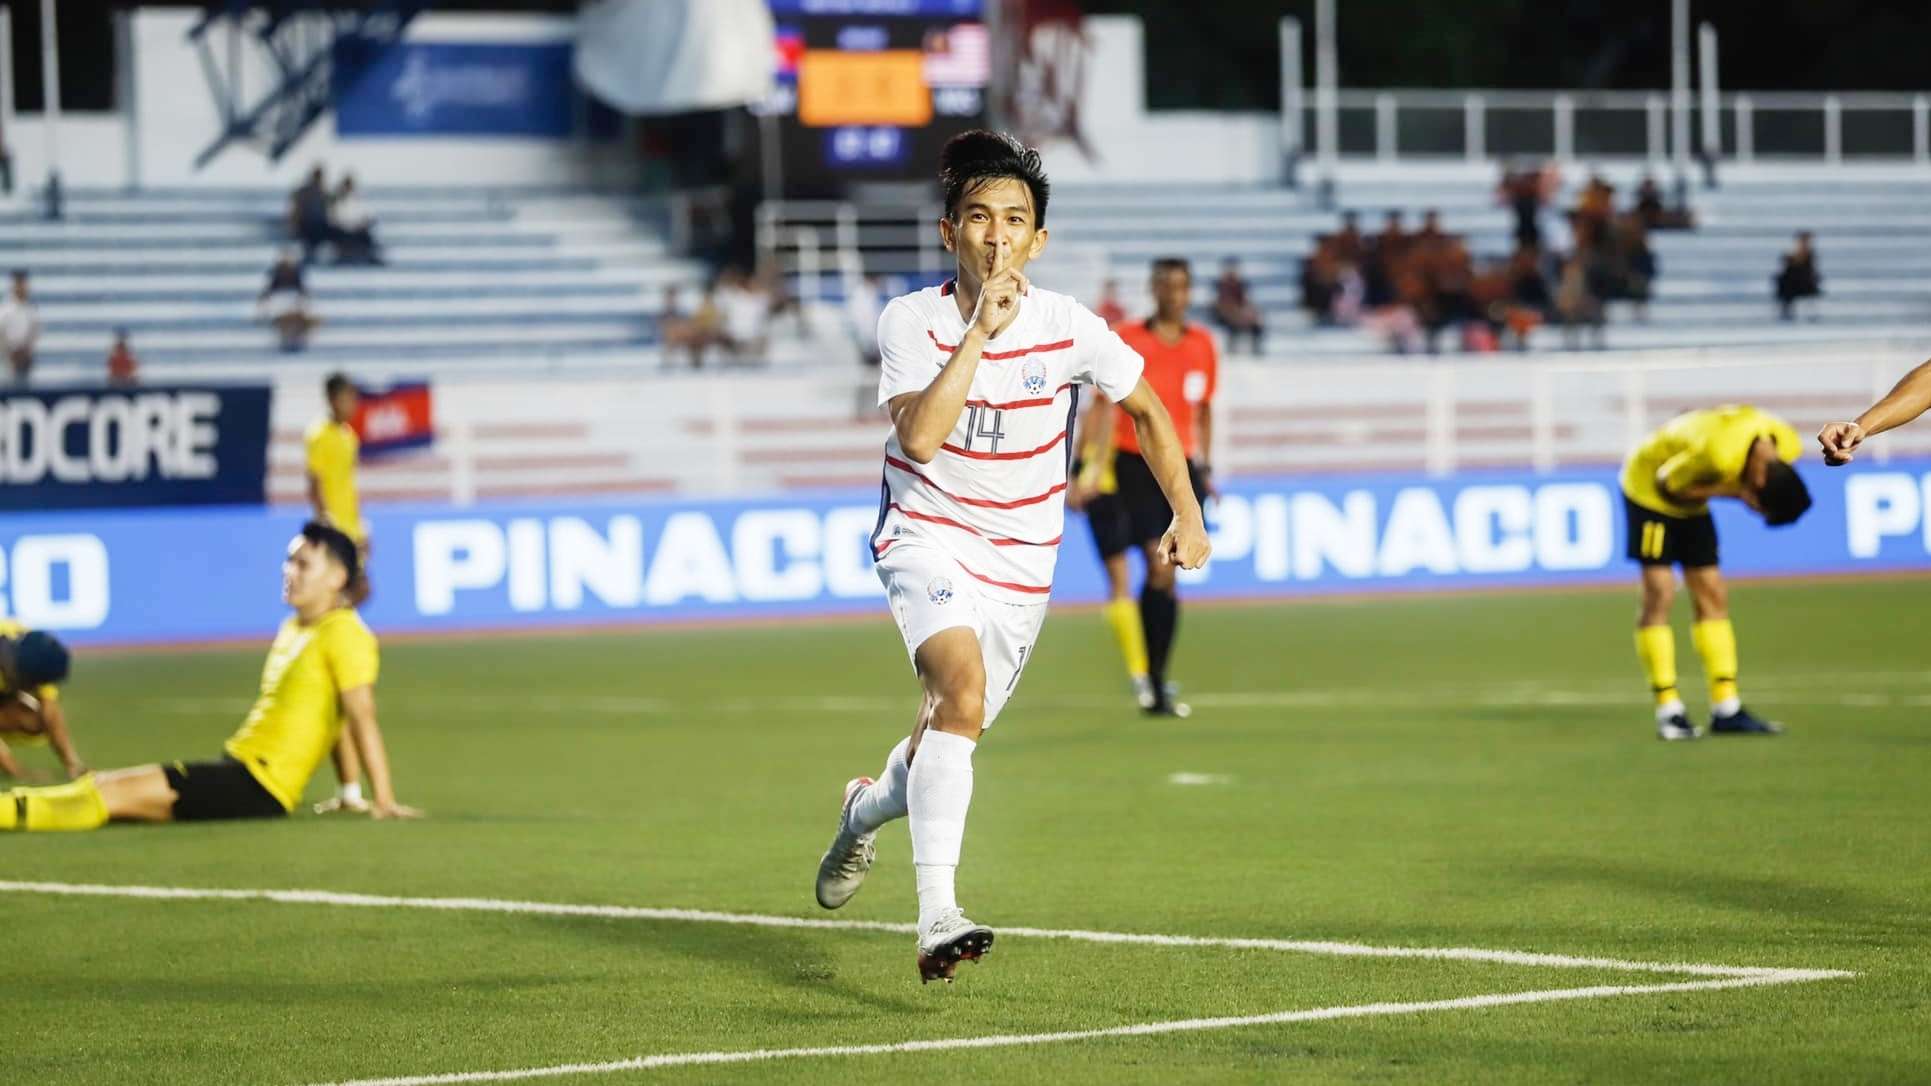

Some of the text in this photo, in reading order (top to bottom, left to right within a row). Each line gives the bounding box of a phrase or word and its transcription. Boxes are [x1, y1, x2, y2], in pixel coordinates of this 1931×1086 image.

[0, 392, 220, 483] DCORE
[964, 404, 1005, 454] 14
[1174, 482, 1614, 584] PINACO
[1641, 521, 1665, 559] 11
[1845, 473, 1931, 558] P
[0, 534, 110, 629] O
